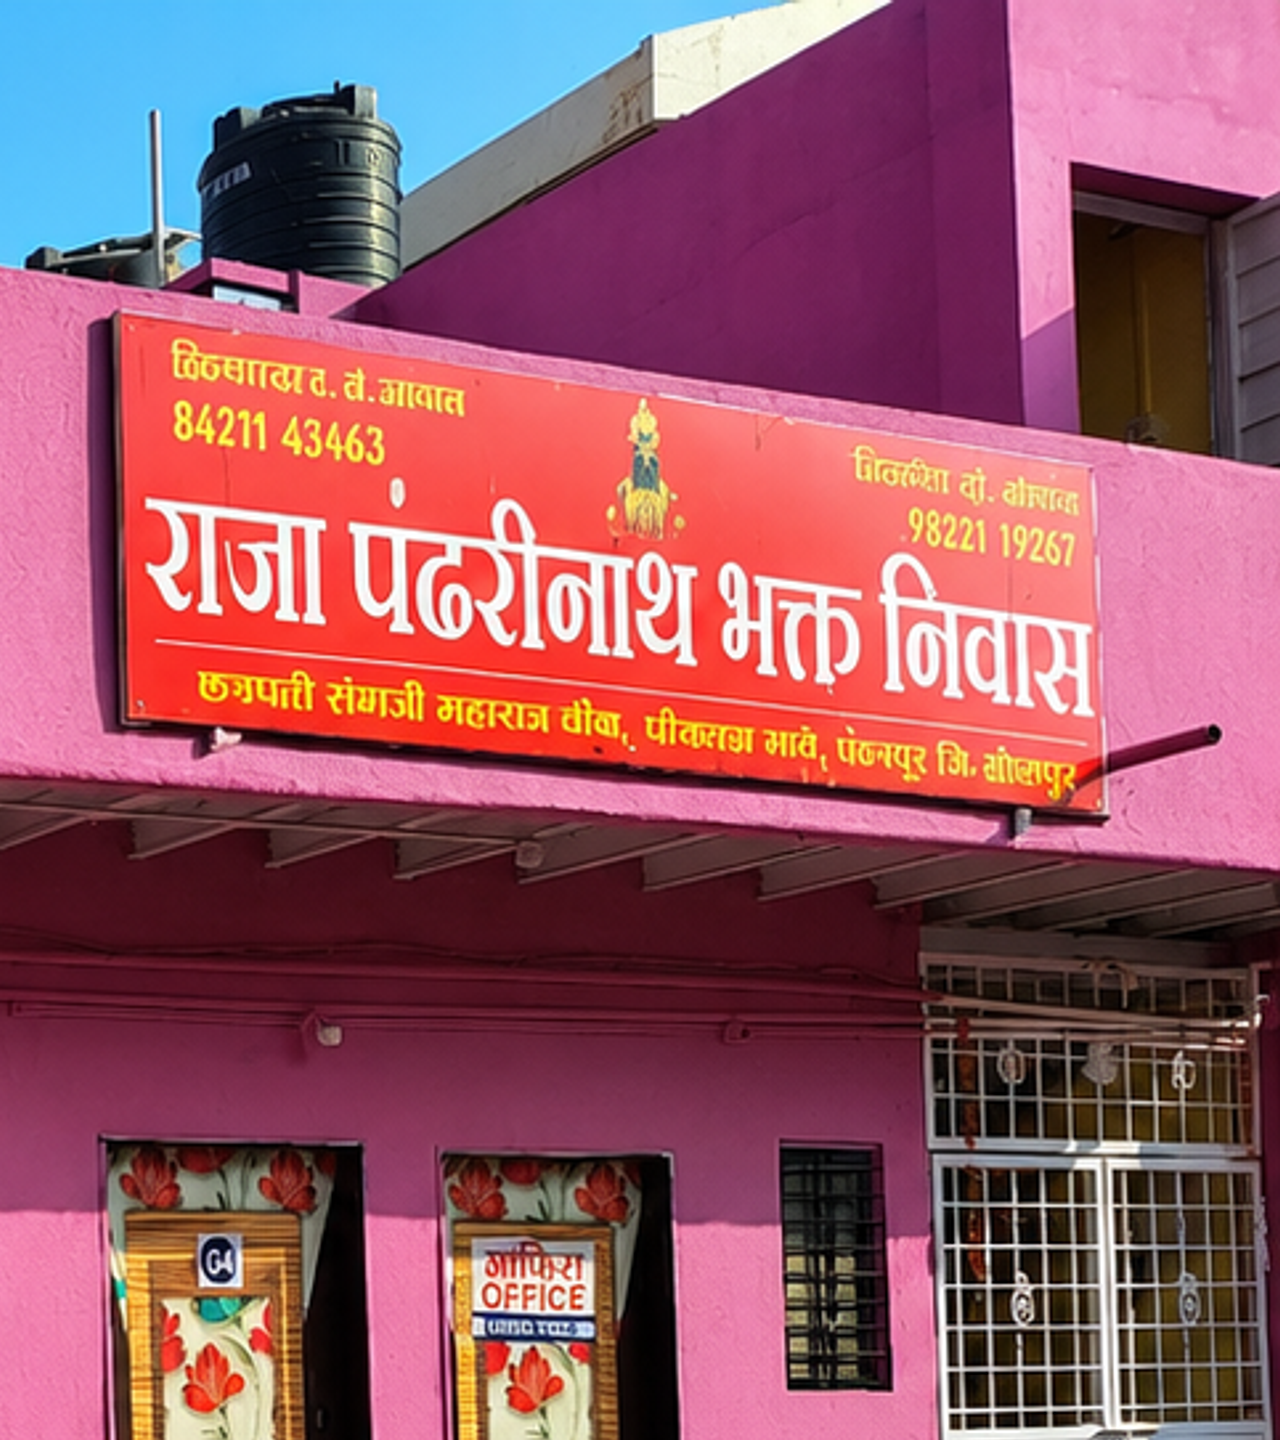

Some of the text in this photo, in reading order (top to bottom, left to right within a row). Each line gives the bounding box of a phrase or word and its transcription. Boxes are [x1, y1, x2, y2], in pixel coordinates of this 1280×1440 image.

[173, 400, 385, 465] 84211 43463
[908, 506, 1076, 567] 98221 19267
[145, 497, 327, 626] राजा
[348, 477, 699, 667] पंढरीनाथ
[717, 561, 863, 685] भक्त
[878, 552, 1096, 718] निवास
[481, 1281, 585, 1311] OFFICE
